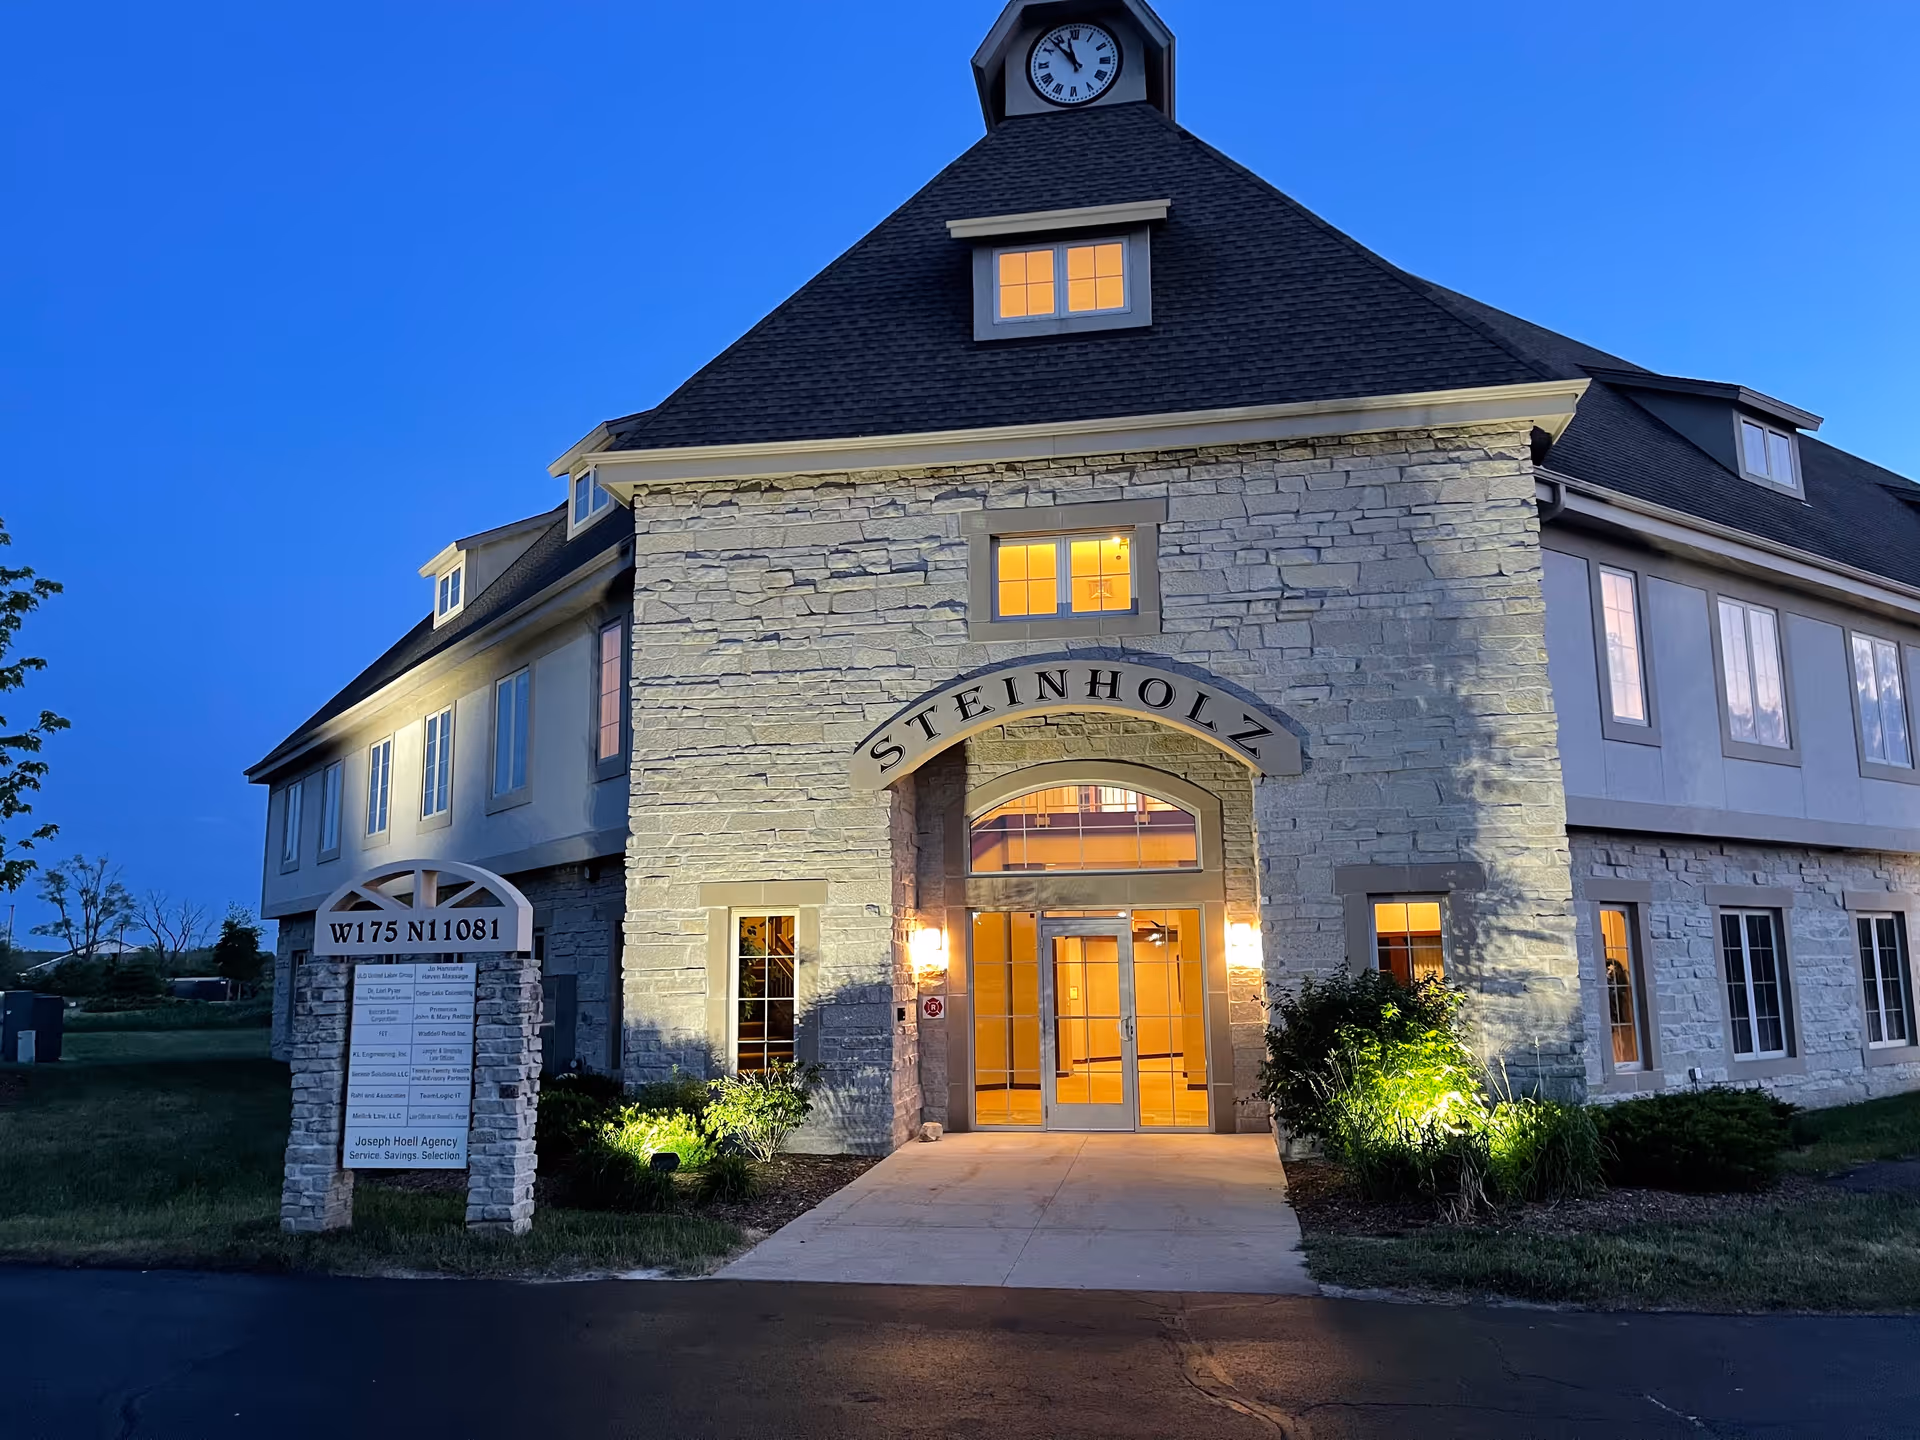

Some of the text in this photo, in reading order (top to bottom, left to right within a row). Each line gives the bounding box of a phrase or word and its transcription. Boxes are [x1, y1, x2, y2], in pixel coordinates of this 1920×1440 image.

[869, 668, 1274, 774] STEINHOLZ
[329, 917, 500, 944] W175 N11081
[355, 1136, 458, 1148] Joseph Hoell Agency
